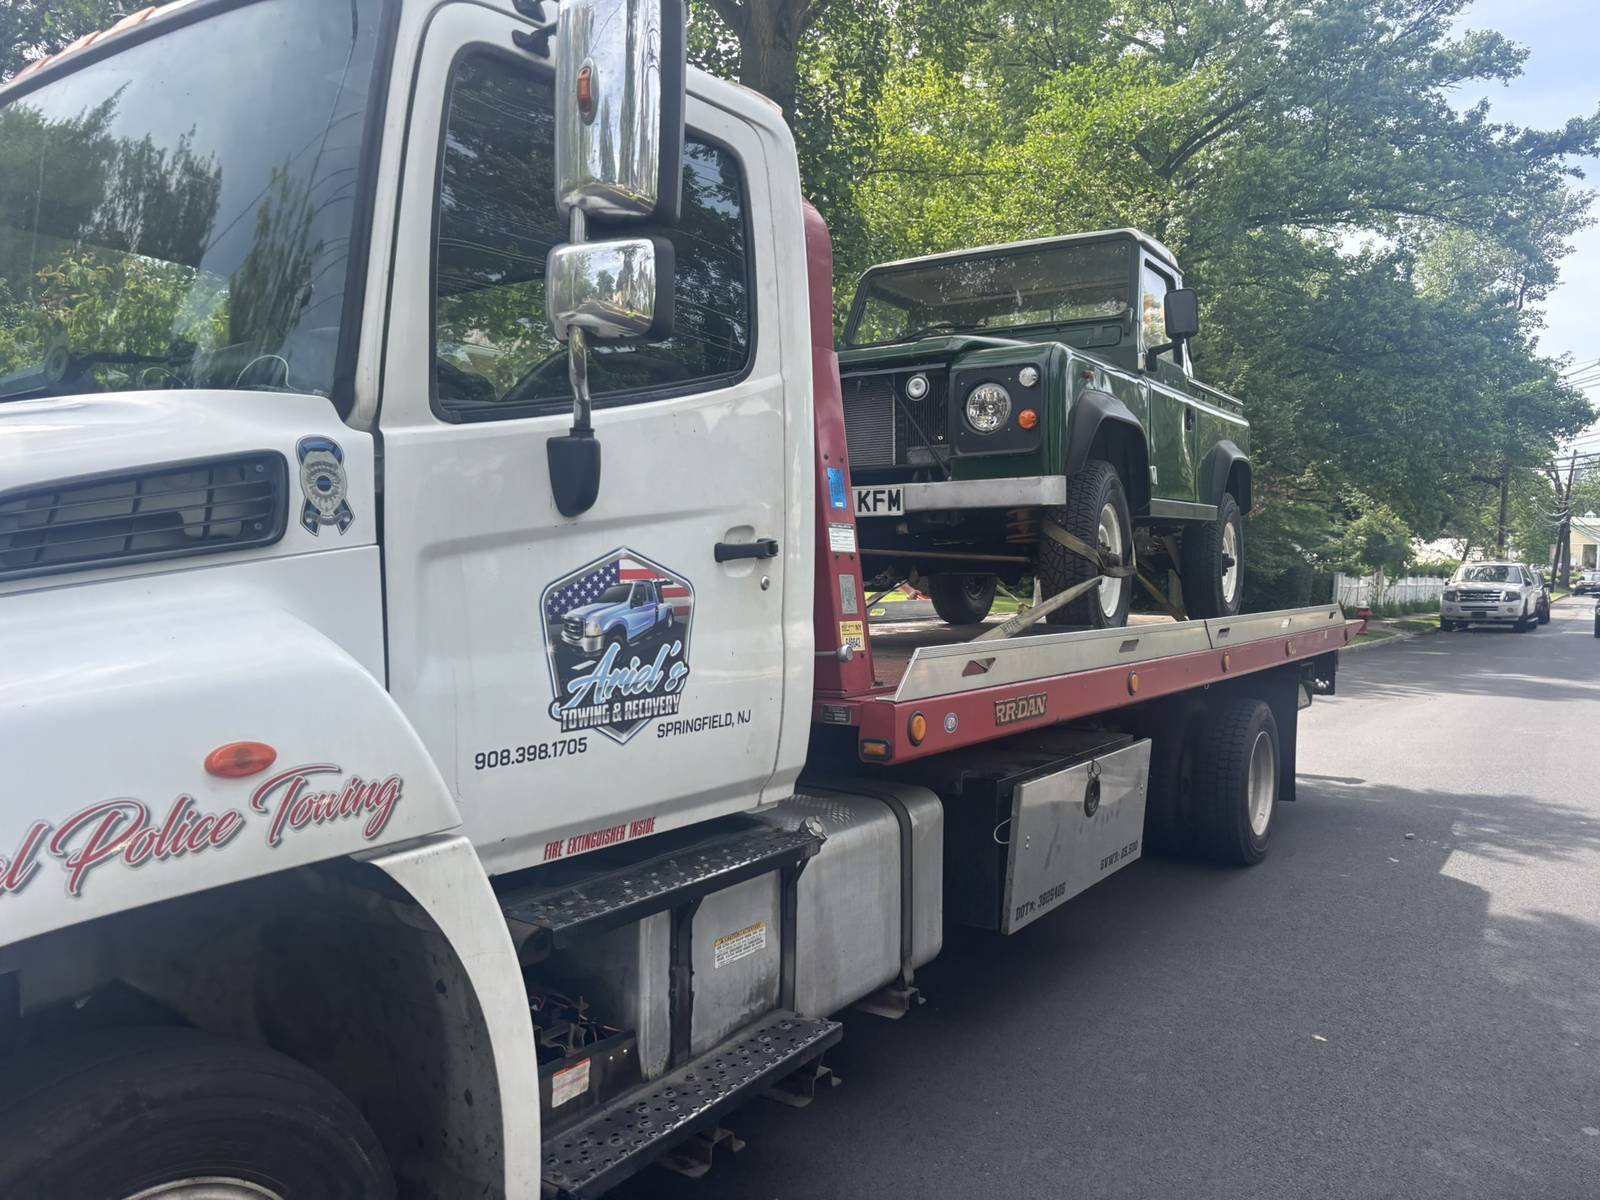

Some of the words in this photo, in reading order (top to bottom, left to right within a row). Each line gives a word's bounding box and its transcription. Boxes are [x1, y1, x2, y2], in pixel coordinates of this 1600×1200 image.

[857, 489, 901, 513] KFM
[551, 640, 688, 718] Ariel's
[560, 703, 610, 731] TOWING
[612, 702, 622, 722] &
[624, 694, 681, 720] RECOVERY
[657, 713, 734, 739] SPRINGFIELD,
[736, 709, 752, 724] NJ
[474, 736, 588, 770] 908.398.1705
[49, 794, 244, 898] Police
[250, 763, 403, 848] Towing
[543, 840, 564, 860] FIRE
[567, 824, 627, 855] EXTINGUISHER
[629, 816, 657, 838] INSIDE
